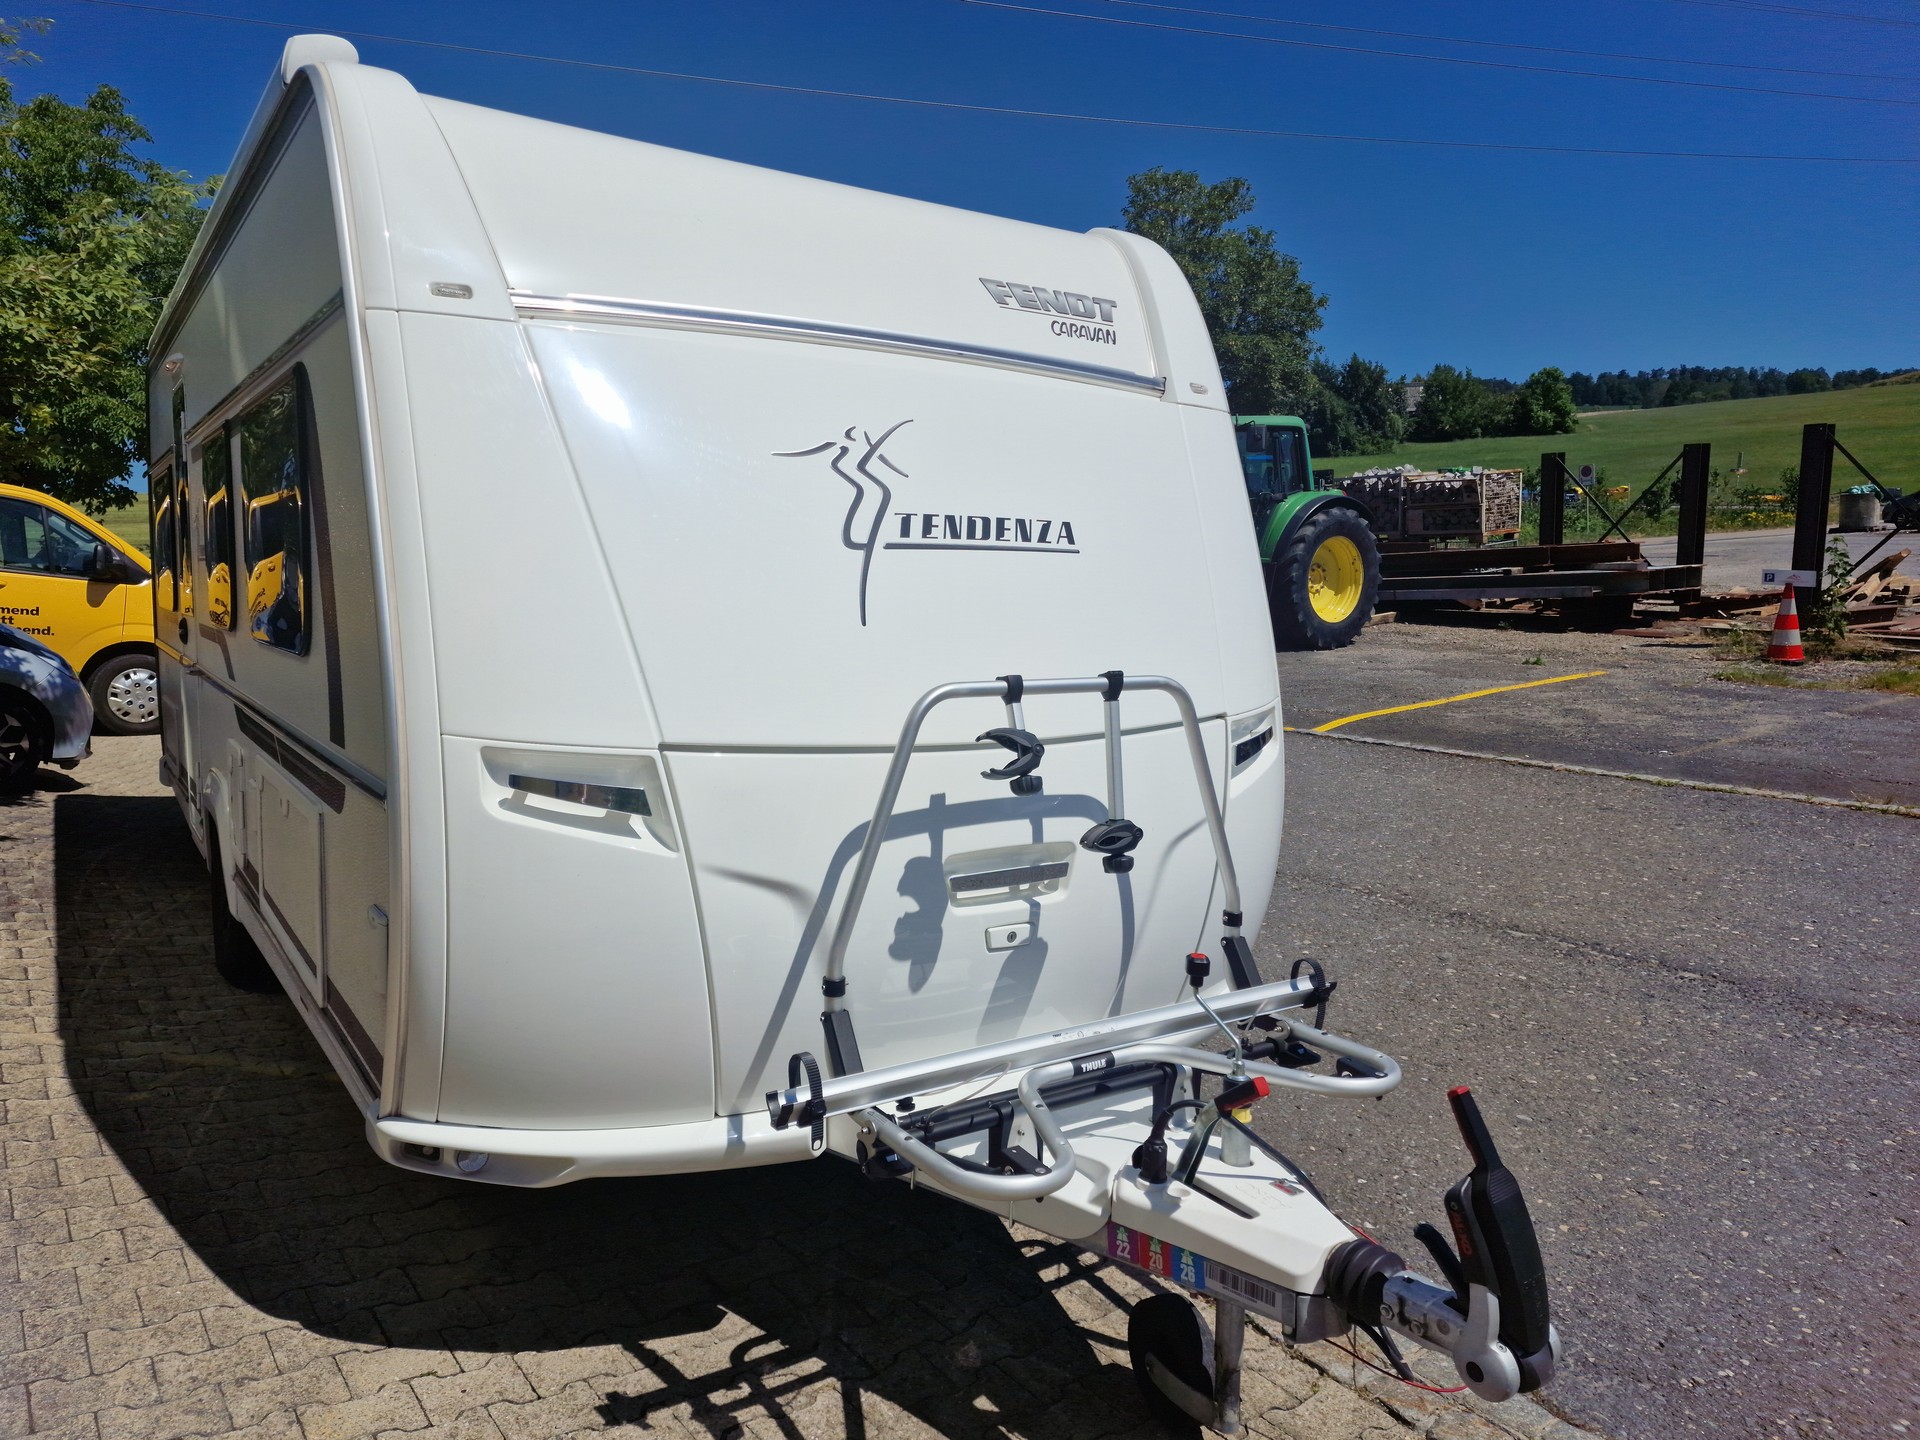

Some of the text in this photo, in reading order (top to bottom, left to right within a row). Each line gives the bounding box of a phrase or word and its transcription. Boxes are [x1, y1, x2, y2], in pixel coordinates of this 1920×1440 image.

[979, 277, 1117, 323] FENDT
[1050, 320, 1117, 345] CARAVAN
[894, 512, 1076, 546] TENDENZA
[1081, 1058, 1107, 1073] THULE
[1116, 1240, 1131, 1259] 22
[1150, 1251, 1163, 1270] 20
[1180, 1264, 1196, 1283] 26
